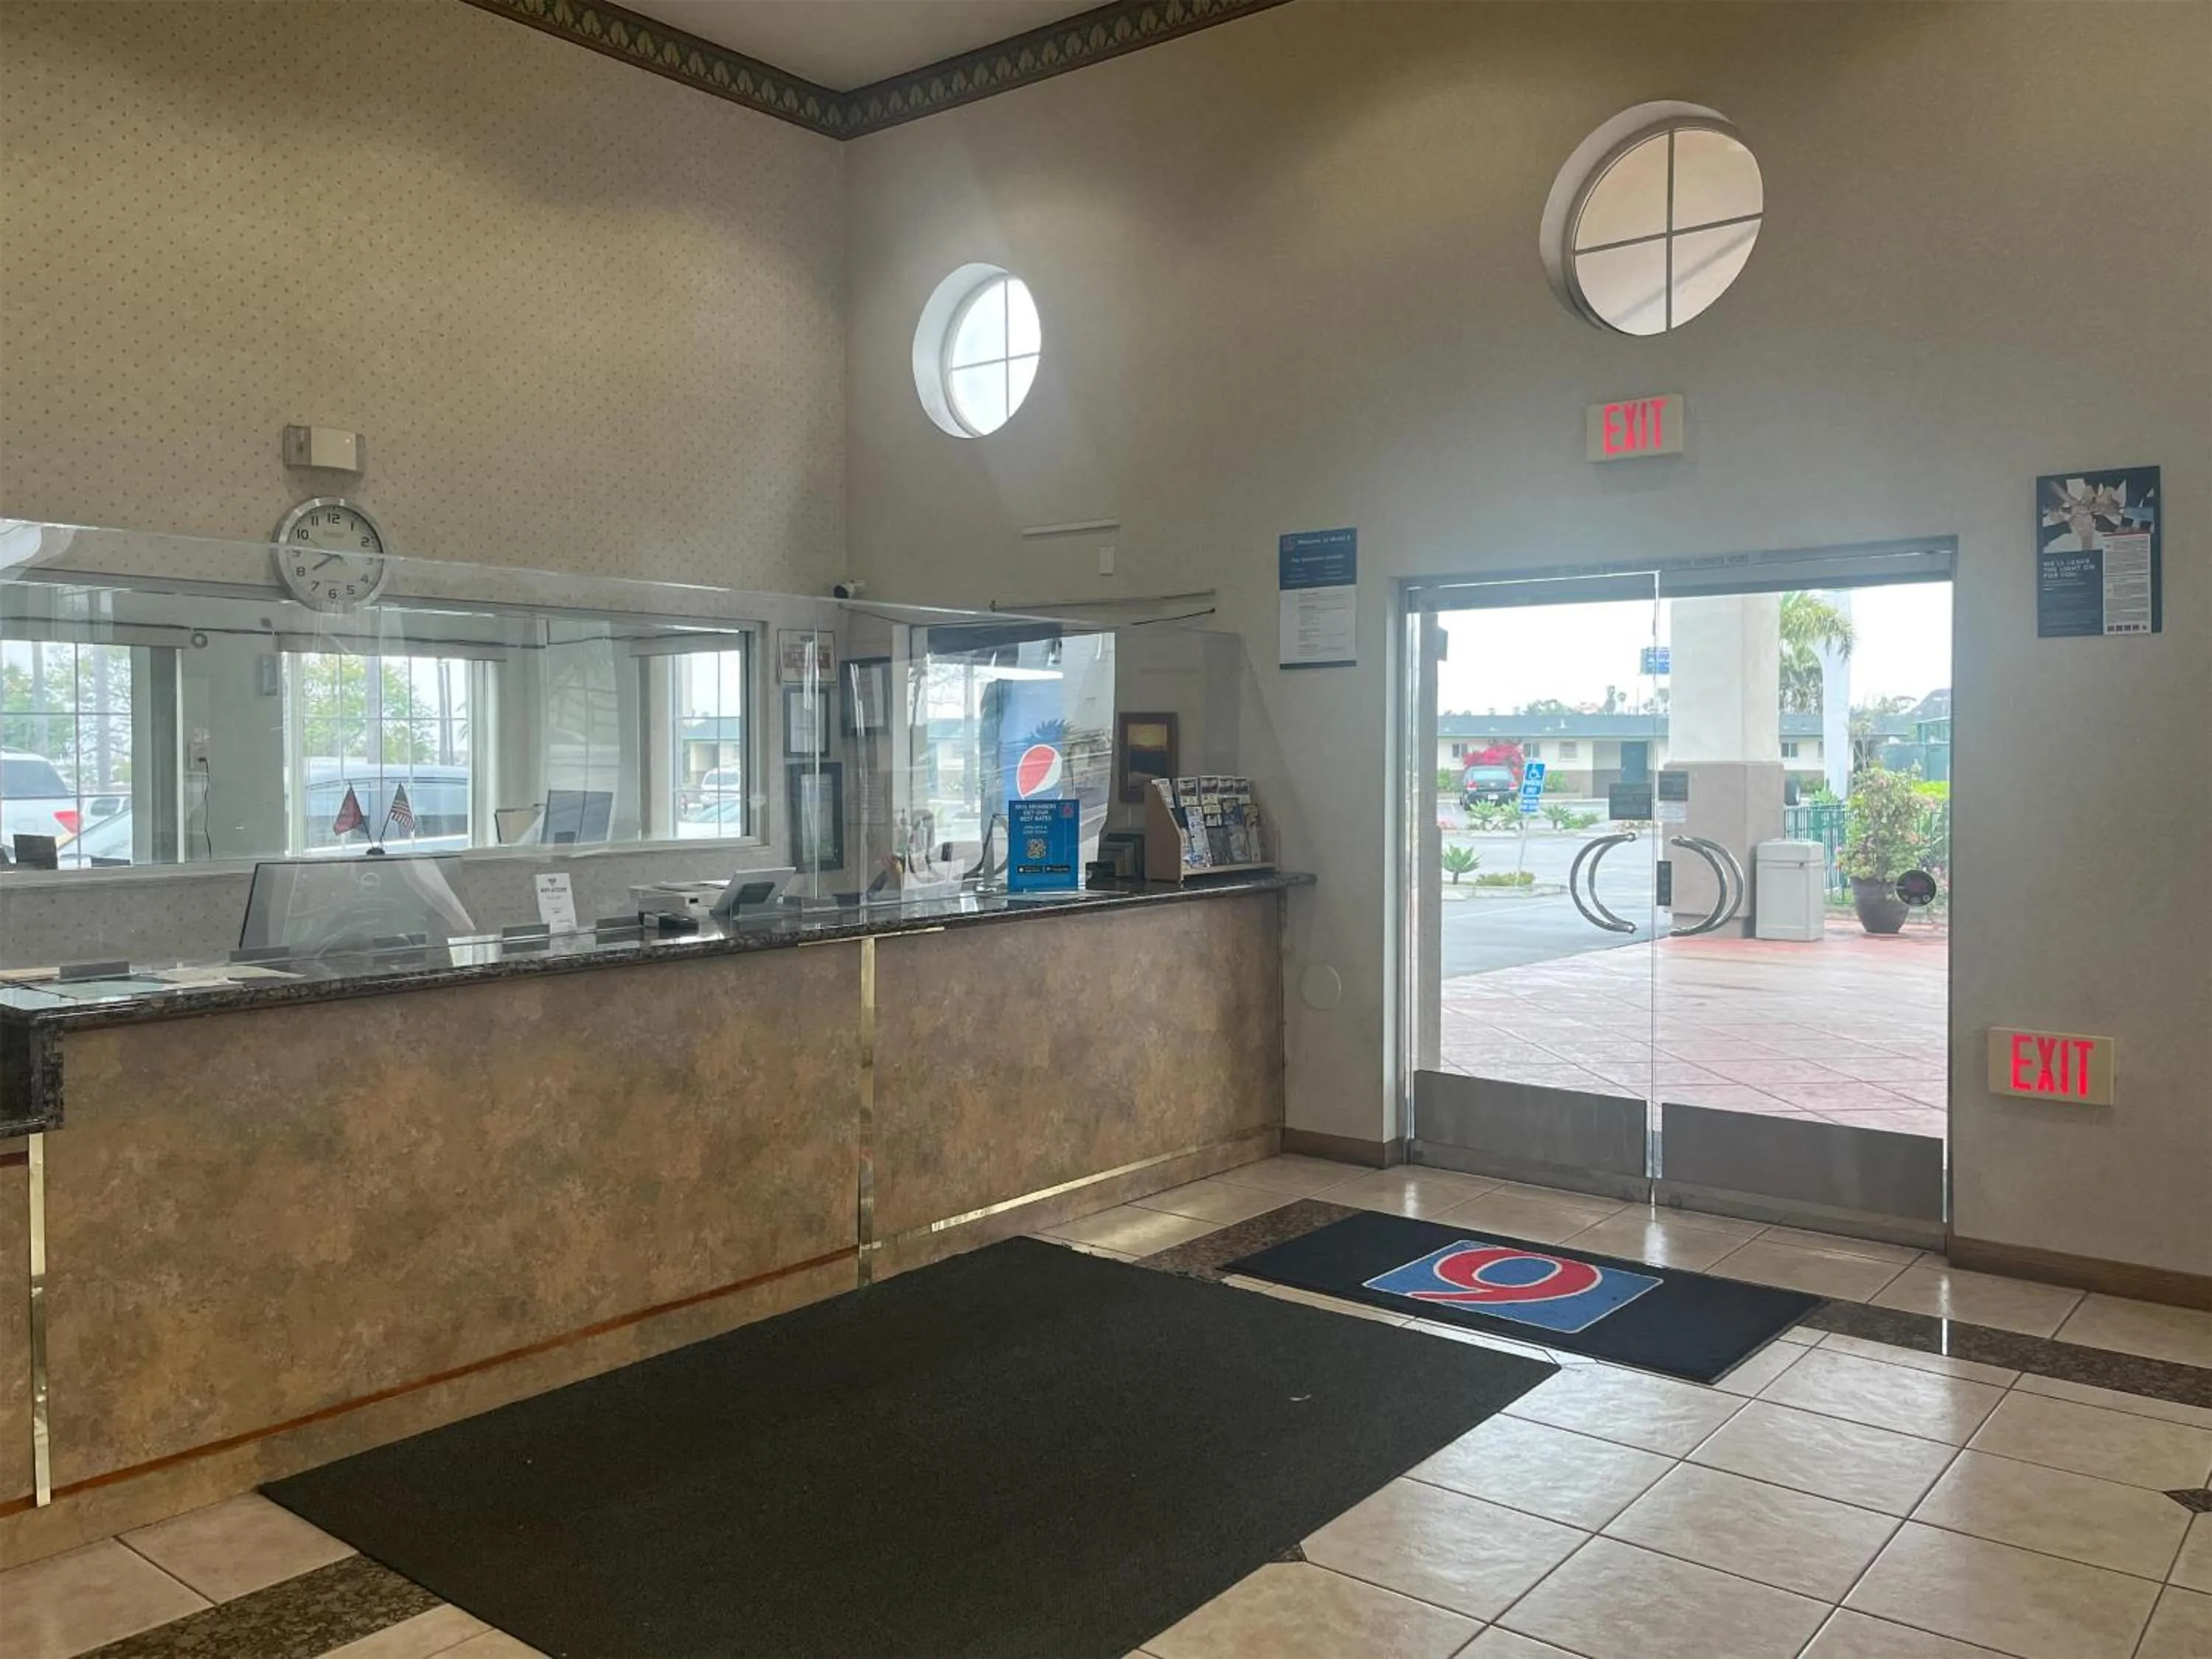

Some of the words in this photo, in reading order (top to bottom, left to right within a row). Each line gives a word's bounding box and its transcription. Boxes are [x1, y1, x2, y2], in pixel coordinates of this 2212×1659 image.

[1604, 399, 1669, 454] EXIT
[311, 516, 319, 526] 11
[327, 513, 340, 524] 12
[350, 521, 354, 531] 1
[296, 529, 309, 540] 10
[361, 536, 369, 547] 2
[296, 566, 306, 577] 8
[361, 574, 369, 583] 4
[311, 580, 320, 591] 7
[347, 585, 355, 595] 5
[328, 588, 337, 599] 6
[2011, 1034, 2095, 1098] EXIT
